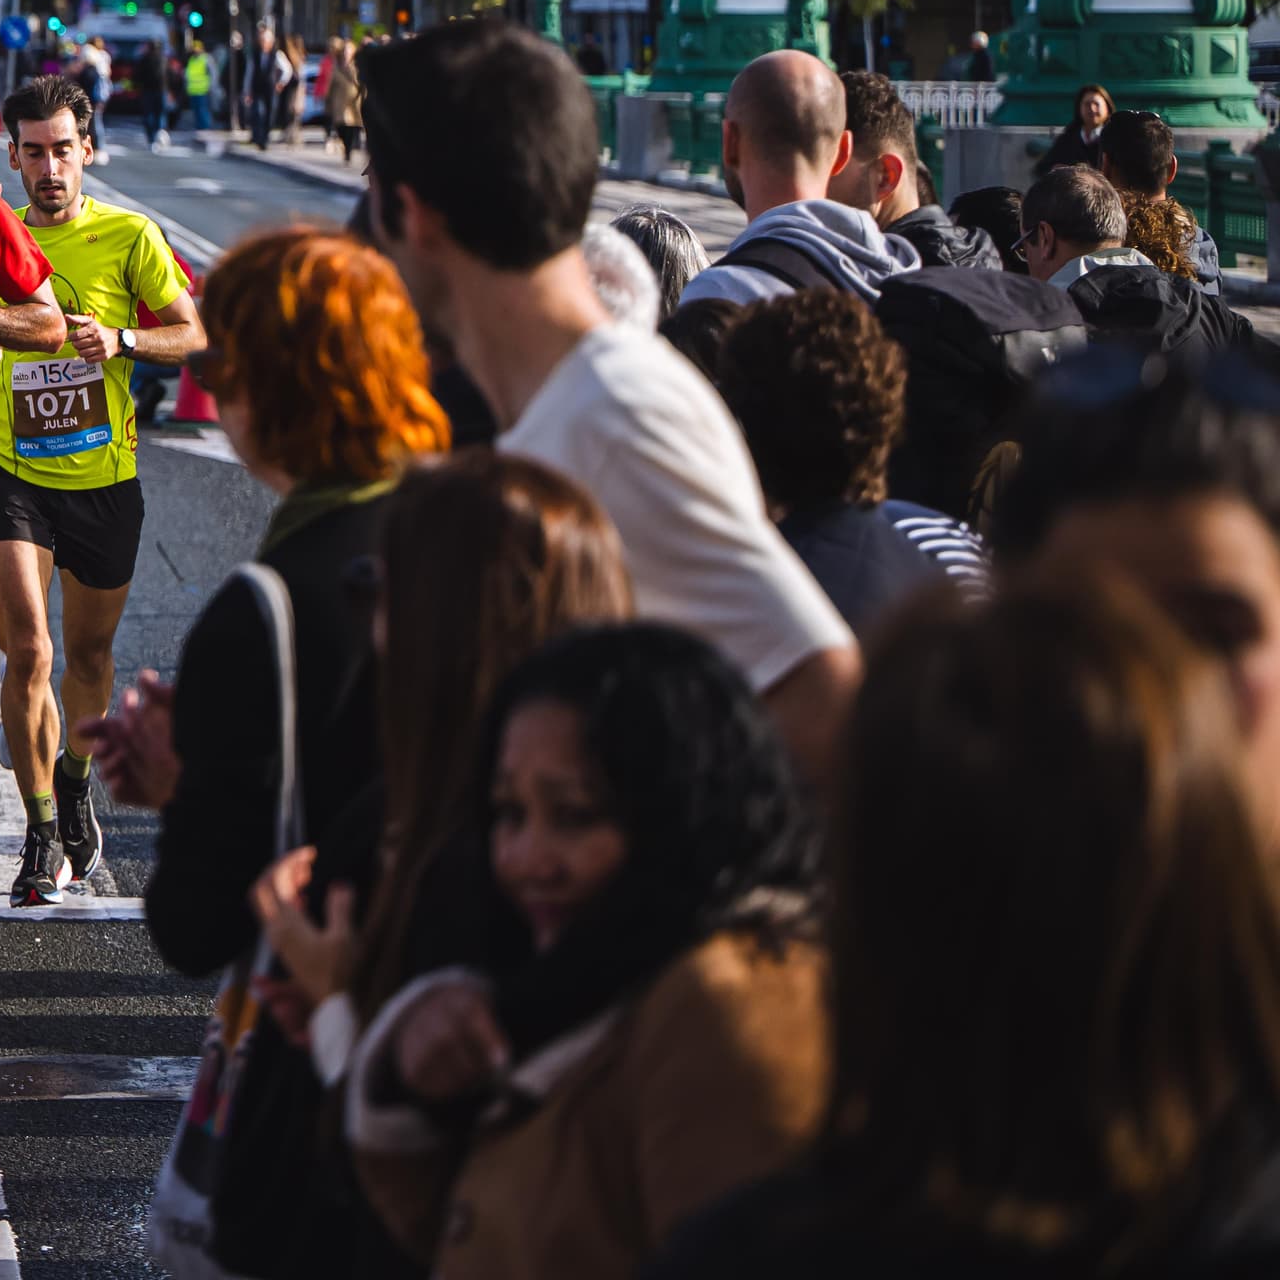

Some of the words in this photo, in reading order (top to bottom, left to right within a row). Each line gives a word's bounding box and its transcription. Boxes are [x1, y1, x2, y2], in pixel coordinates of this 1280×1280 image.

[25, 387, 90, 419] 1071
[43, 416, 78, 430] JULEN
[20, 442, 40, 450] DKV
